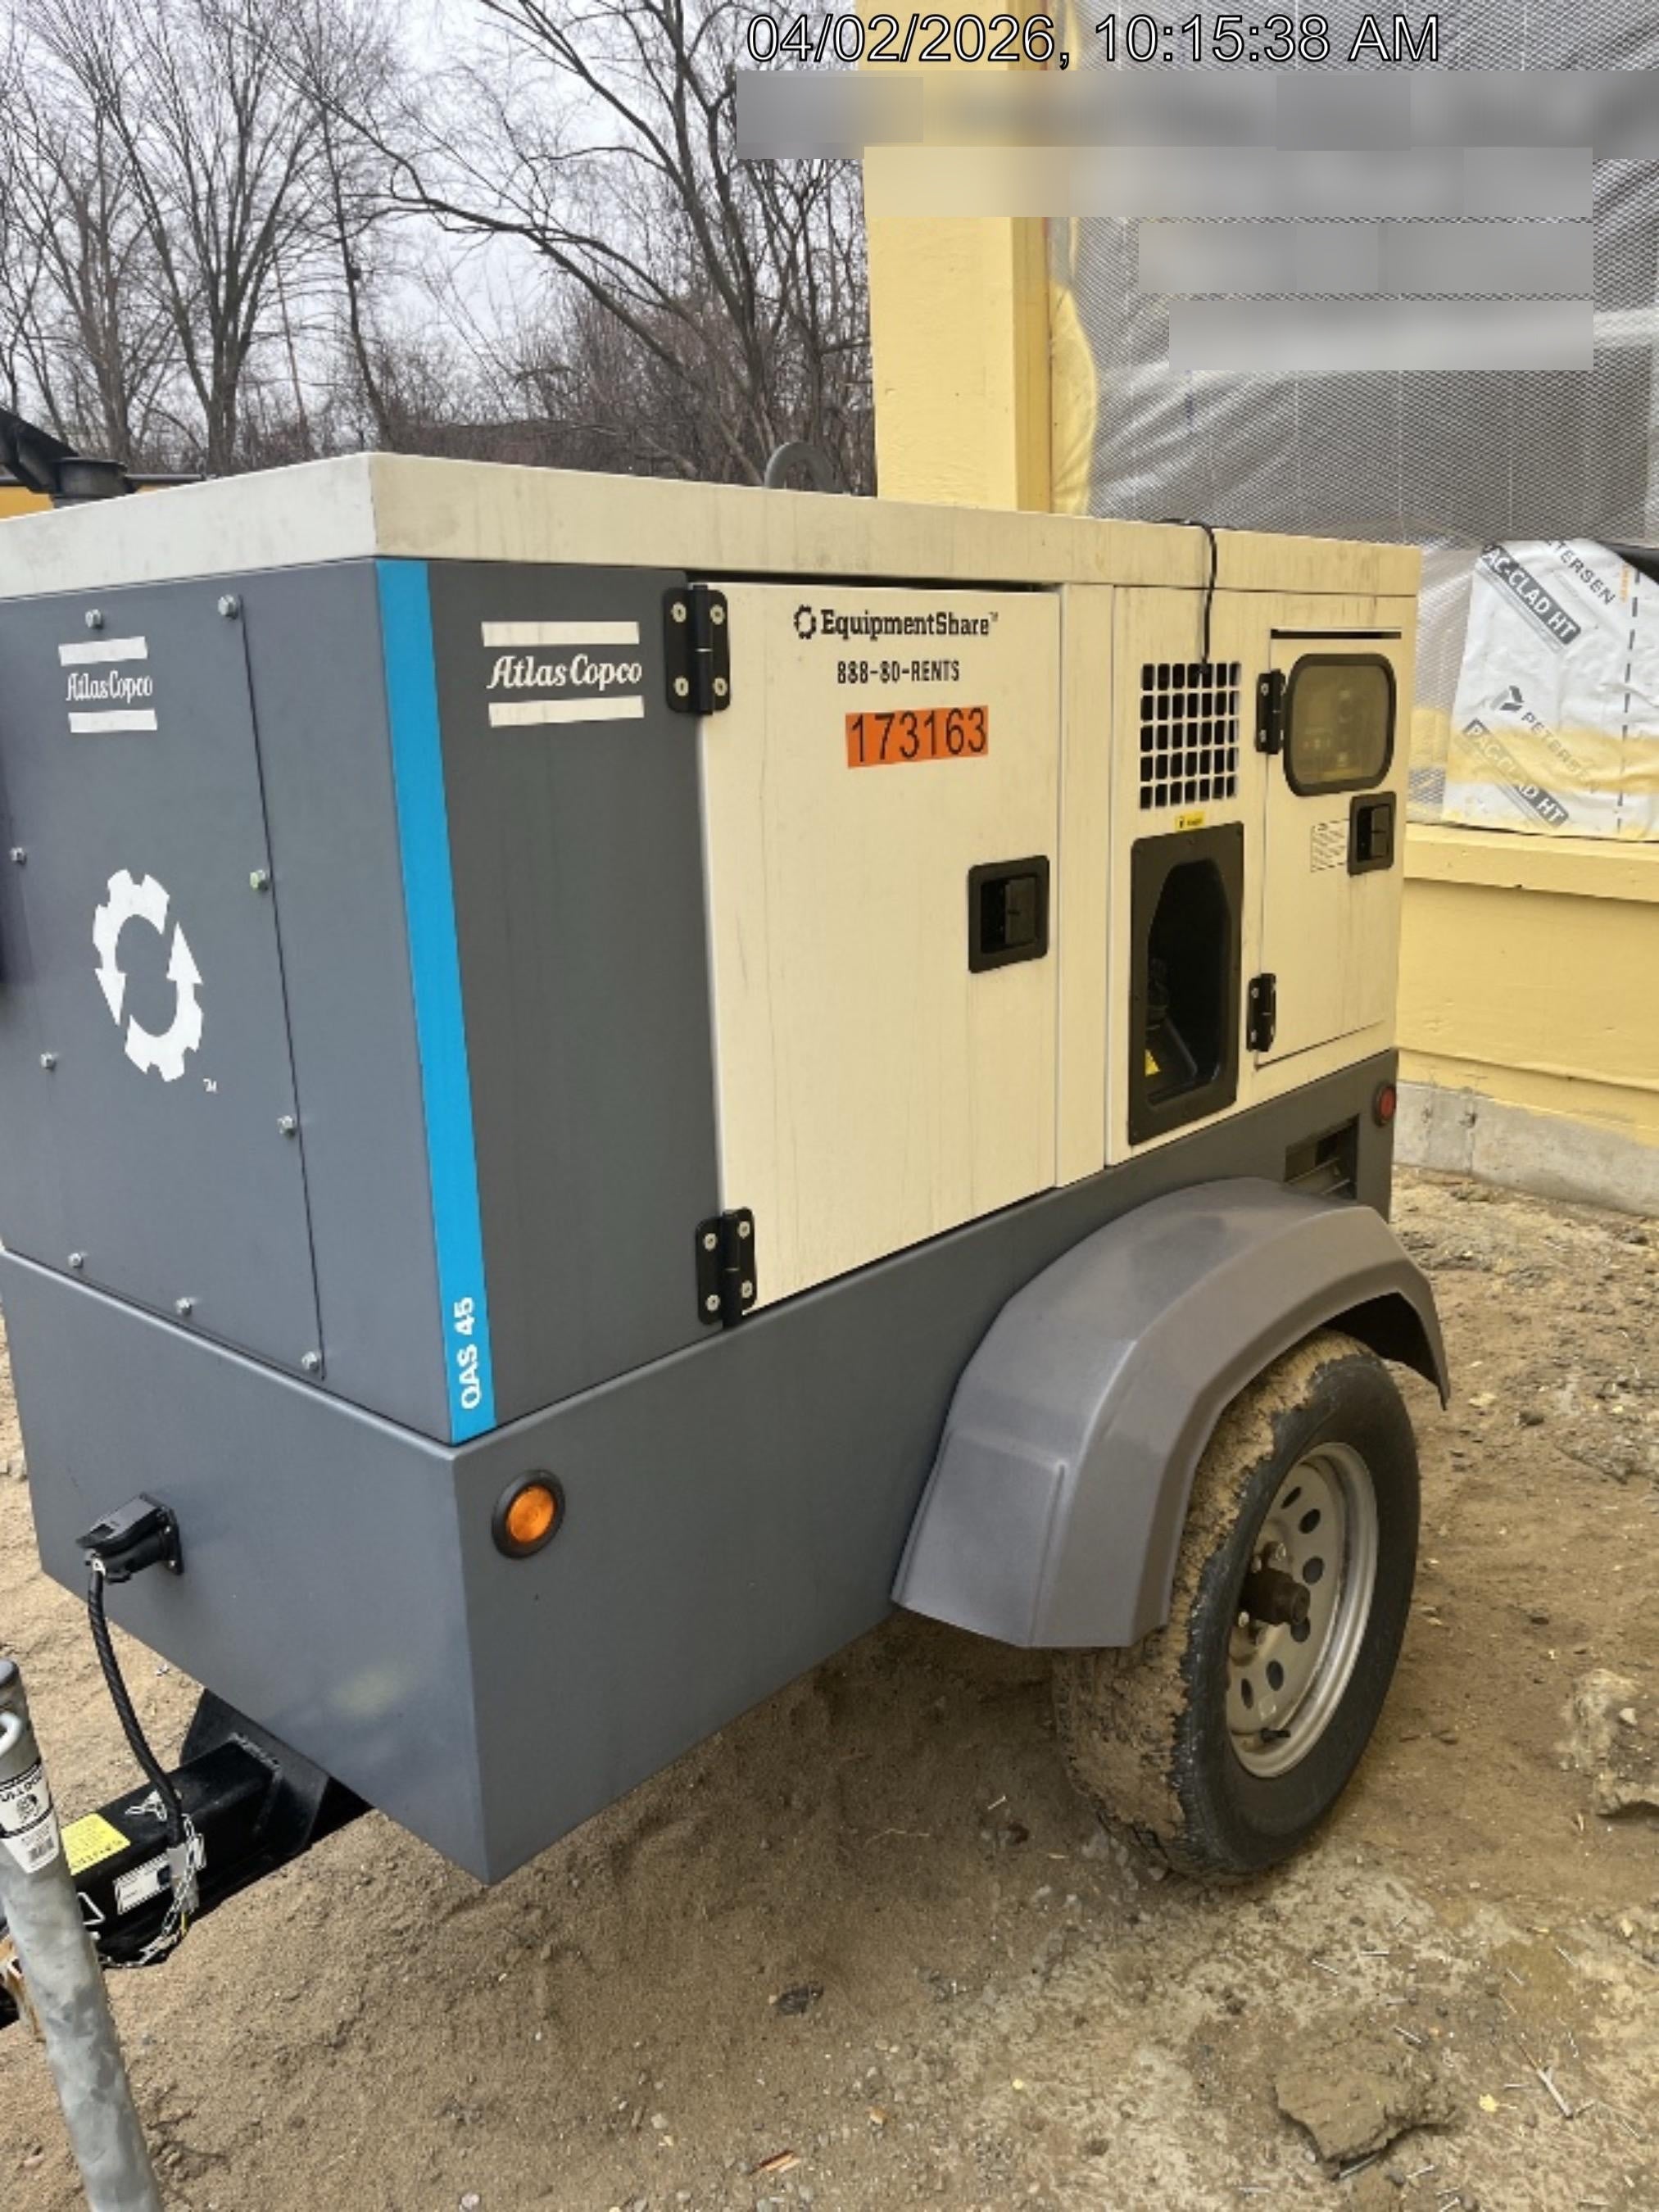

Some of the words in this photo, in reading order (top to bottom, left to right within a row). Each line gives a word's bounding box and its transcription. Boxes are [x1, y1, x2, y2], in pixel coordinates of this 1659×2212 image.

[820, 609, 990, 641] EquipmentShare
[1548, 611, 1576, 638] HT
[66, 672, 109, 701] Atlas
[109, 669, 153, 704] Copco
[486, 655, 568, 690] Atlas
[569, 653, 643, 691] Copco
[836, 660, 960, 684] 888-80-RENTS
[851, 706, 987, 763] 173163
[1536, 797, 1565, 823] HT
[453, 1296, 474, 1336] 45
